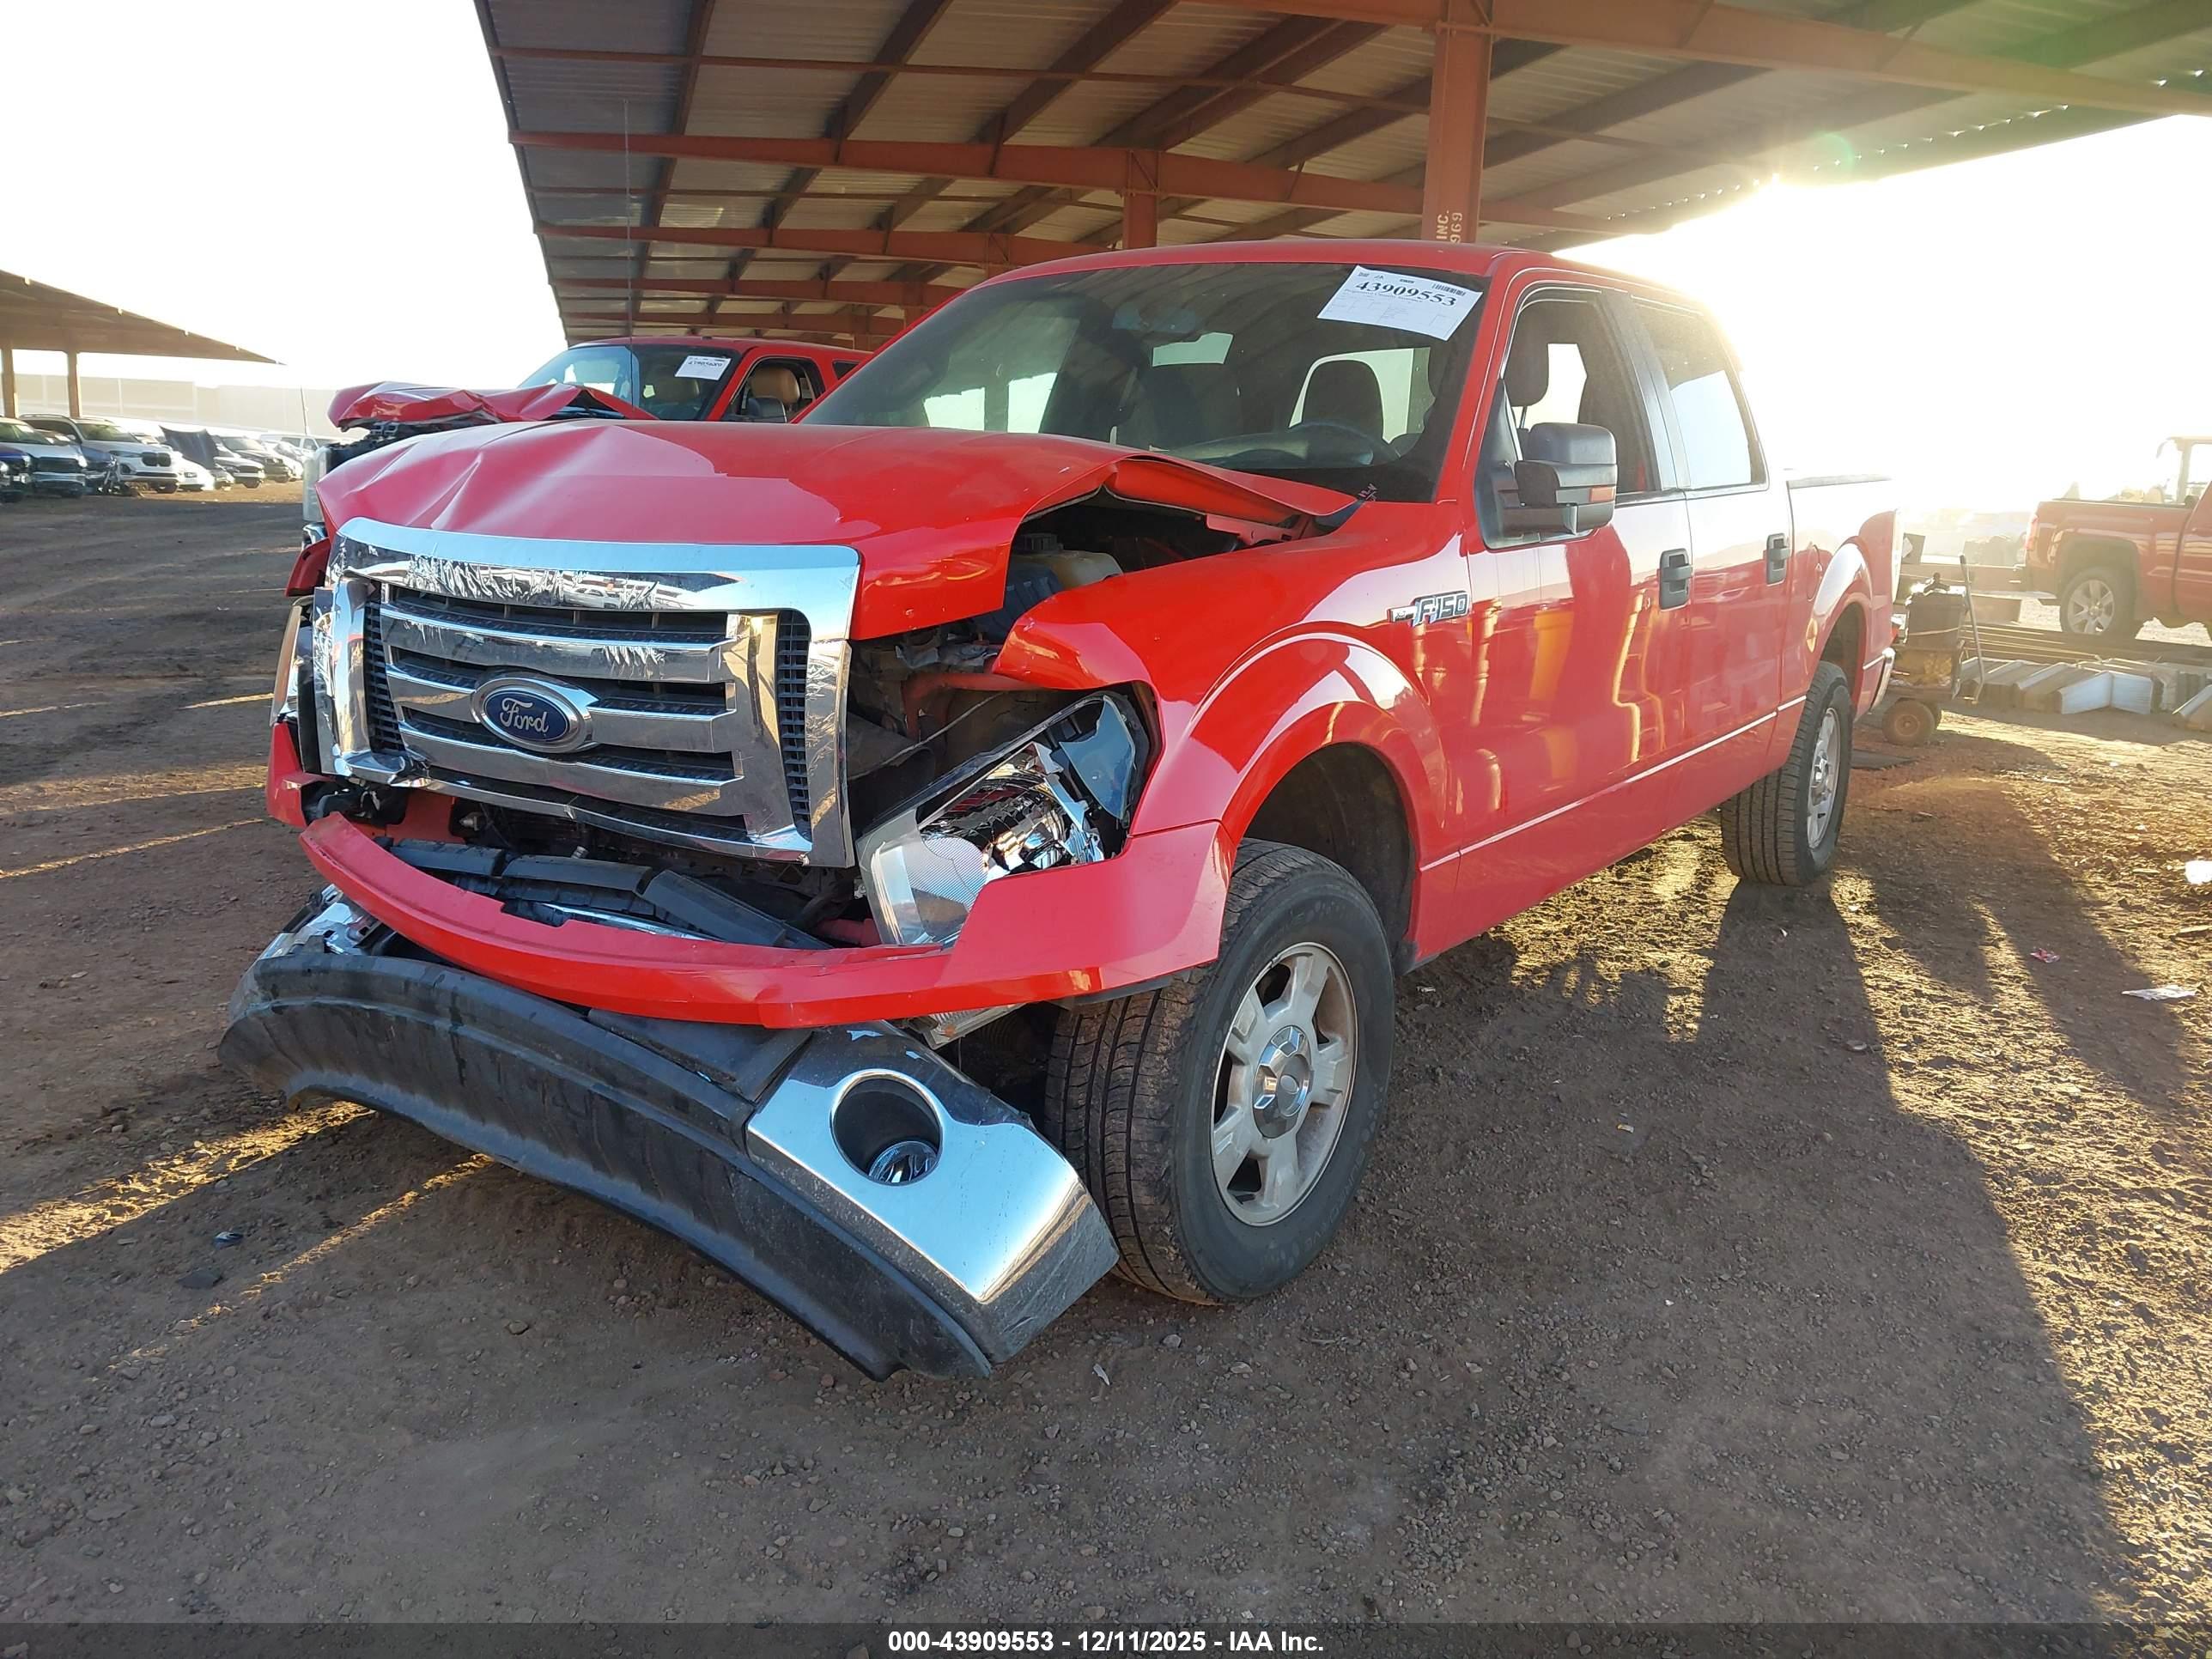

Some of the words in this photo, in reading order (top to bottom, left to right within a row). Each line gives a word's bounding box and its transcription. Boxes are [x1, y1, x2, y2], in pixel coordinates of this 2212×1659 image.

[1436, 210, 1449, 240] INC.
[1356, 280, 1456, 307] 43909553
[500, 697, 550, 733] Ford
